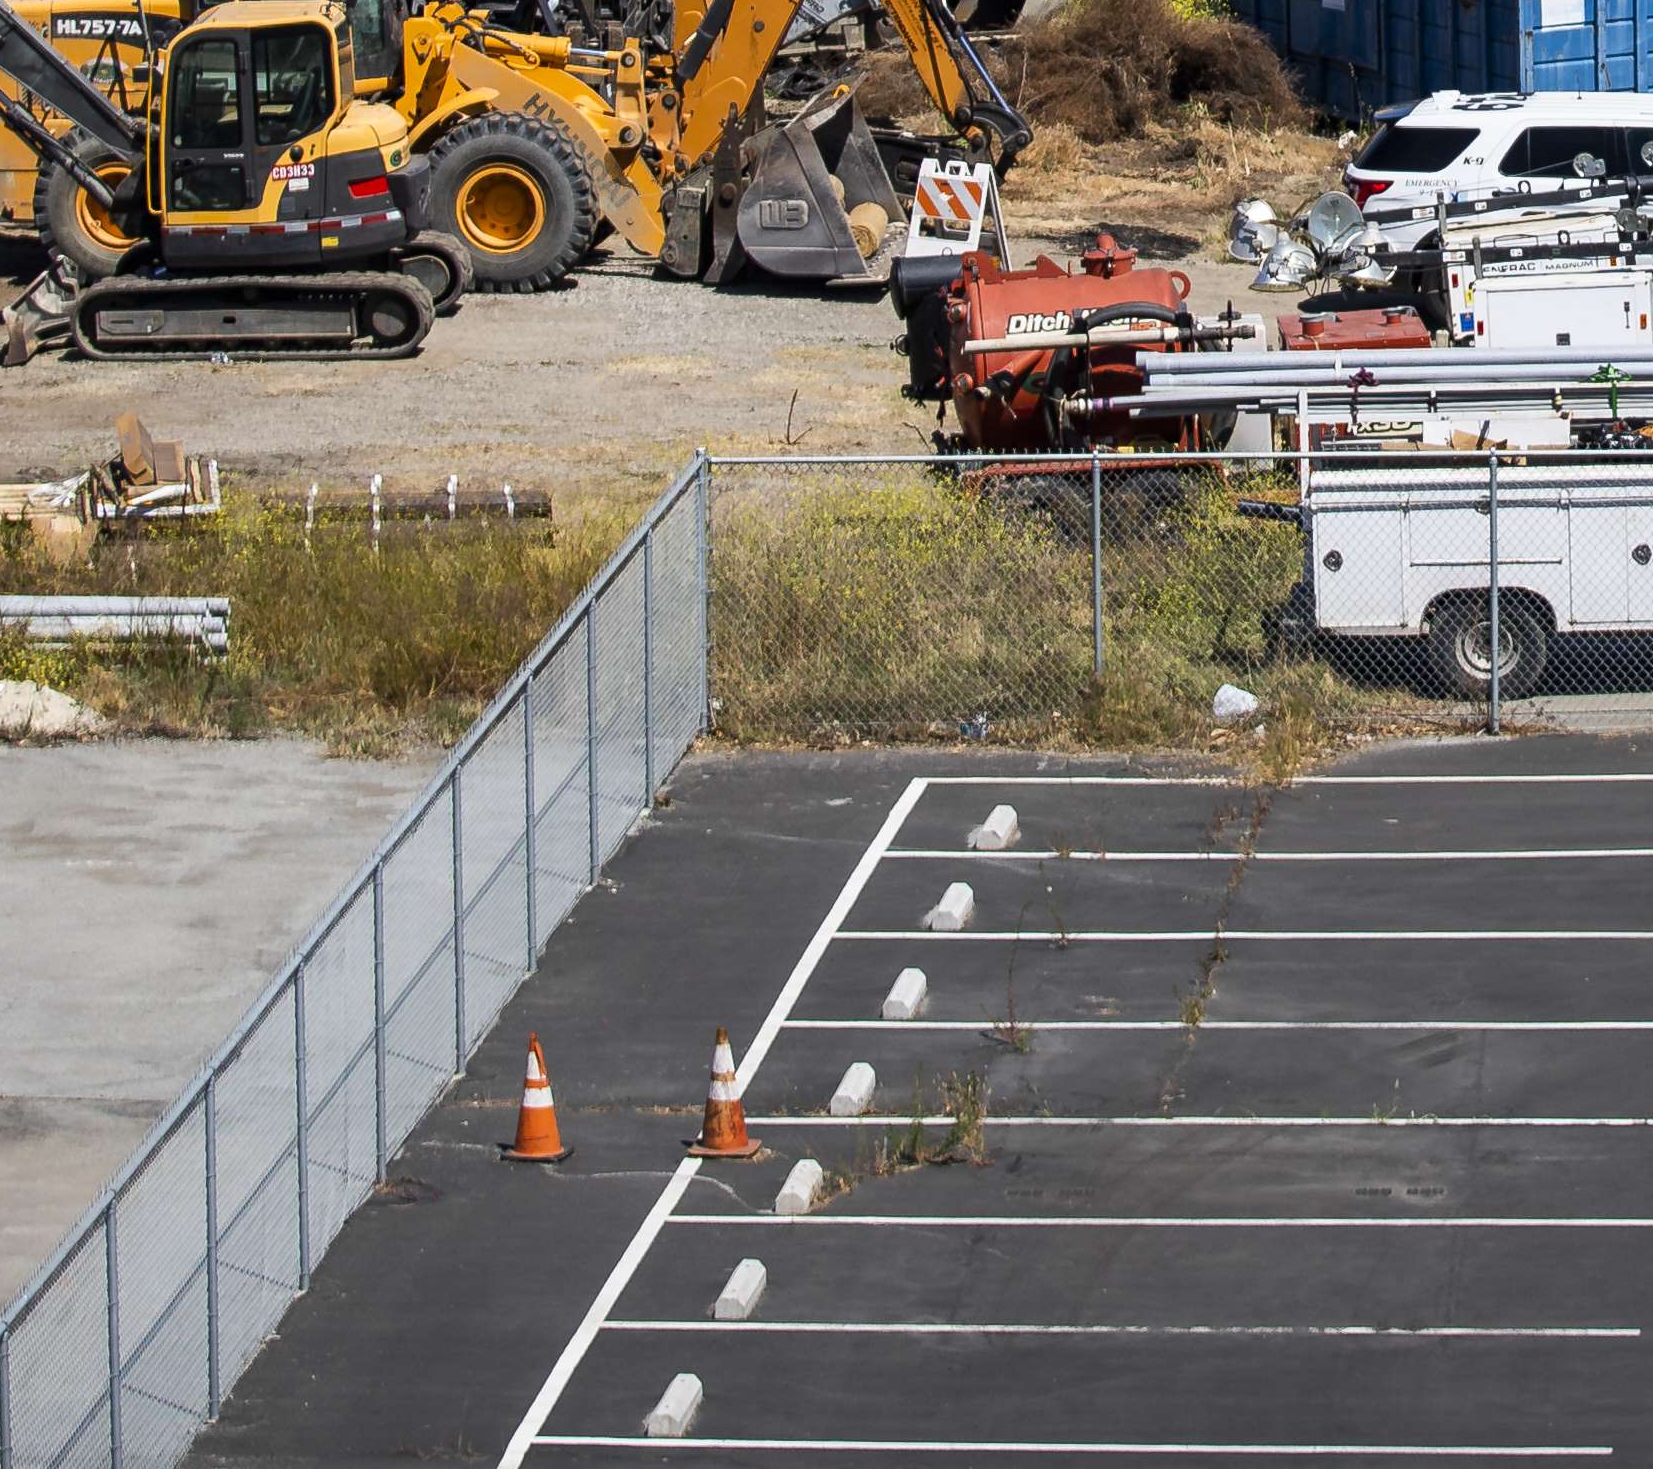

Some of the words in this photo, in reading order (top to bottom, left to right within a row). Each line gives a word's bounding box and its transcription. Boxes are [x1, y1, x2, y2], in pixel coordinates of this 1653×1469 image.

[56, 19, 143, 35] HL757-7A
[1405, 179, 1458, 187] EMERGENCY
[1007, 311, 1071, 335] Ditch
